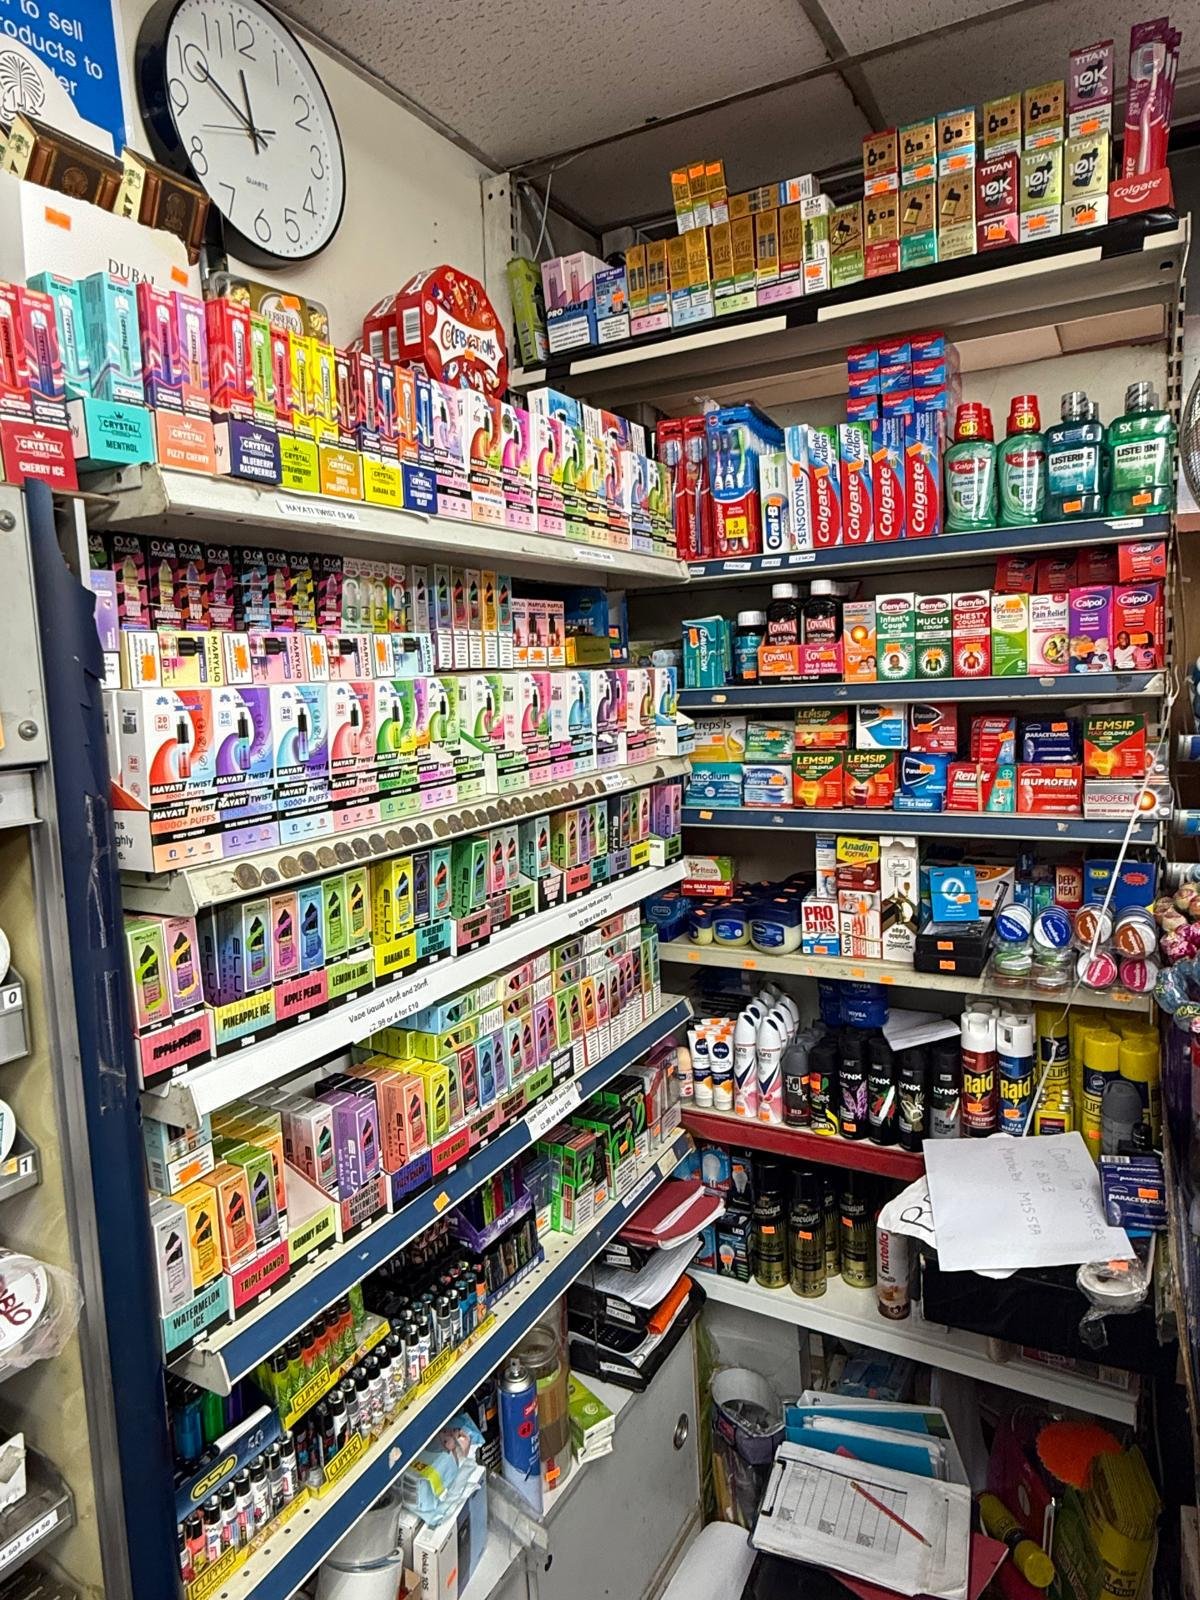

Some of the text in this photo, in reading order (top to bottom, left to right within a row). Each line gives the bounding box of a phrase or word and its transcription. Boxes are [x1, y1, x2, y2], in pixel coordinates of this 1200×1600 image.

[21, 0, 83, 42] to sell
[201, 12, 223, 58] 11
[229, 12, 256, 60] 12
[0, 16, 103, 79] oducts to
[175, 35, 209, 83] 10
[1075, 50, 1109, 64] TITAN
[273, 51, 279, 85] 1
[1074, 68, 1108, 87] 10K
[169, 78, 189, 116] 9
[293, 95, 311, 131] 2
[190, 136, 208, 175] 8
[310, 145, 324, 180] 3
[980, 161, 1013, 176] TITAN
[1069, 157, 1101, 177] 10K
[1025, 170, 1056, 188] 10K
[980, 181, 1011, 196] 10K
[1114, 179, 1162, 198] Colgate
[218, 182, 235, 218] 7
[303, 186, 317, 217] 4
[254, 209, 271, 242] 6
[285, 208, 300, 243] 5
[547, 308, 563, 319] PRO
[103, 419, 139, 433] CRYSTAL
[172, 429, 204, 442] CRYSTAL
[20, 438, 61, 454] CRYSTAL
[106, 439, 139, 453] MENTHOL
[243, 440, 273, 453] CRYSTAL
[820, 435, 828, 465] Action
[853, 429, 861, 460] Action
[19, 462, 65, 477] CHERRY ICE
[880, 466, 892, 536] Colgate
[912, 462, 925, 532] Colgate
[286, 504, 314, 514] HAYATI
[818, 475, 830, 542] Colgate
[847, 472, 861, 540] Colgate
[768, 505, 780, 546] Oral-B
[1131, 544, 1153, 553] Calpol
[881, 602, 909, 611] Benylin
[920, 602, 947, 611] Benylin
[957, 598, 985, 607] Benylin
[1075, 599, 1104, 608] Calpol
[1119, 595, 1149, 604] Calpol
[880, 615, 909, 624] Infant's
[917, 617, 950, 626] MUCUS
[954, 612, 988, 620] CHESTY
[1032, 609, 1066, 619] Pain Relief
[211, 636, 220, 682] MARYLIQ
[292, 636, 302, 679] MARYLIQ
[362, 637, 370, 677] MARYLIQ
[763, 652, 793, 663] COVONIA
[798, 710, 831, 719] LEMSIP
[1088, 720, 1135, 730] LEMSIP
[797, 756, 834, 765] LEMSIP
[847, 755, 886, 763] LEMSIP
[217, 772, 270, 785] HAYATI TWIST
[279, 767, 303, 776] HAYATI
[152, 781, 211, 794] HAYATI TWIST
[1020, 778, 1077, 786] IBUPROFEN
[279, 784, 327, 797] HAYATI TWIST
[218, 798, 246, 808] HAYATI
[251, 793, 272, 802] TWIST
[283, 799, 306, 808] 5000+
[308, 793, 329, 803] PUFFS
[1088, 794, 1130, 803] NUROFEN
[153, 803, 215, 820] HAYATI TWIST
[189, 814, 216, 823] PUFFS
[841, 842, 873, 853] Anadin
[1058, 875, 1076, 886] DEEP
[1058, 886, 1078, 896] HEAT
[804, 906, 834, 921] PRO
[384, 952, 403, 966] BANANA
[333, 970, 351, 986] LEMON
[357, 964, 369, 977] LIME
[348, 1011, 366, 1023] Vape
[402, 988, 414, 997] and
[399, 1007, 408, 1017] for
[223, 1003, 270, 1030] PINEAPPLE ICE
[839, 1071, 862, 1080] LYNX
[868, 1075, 890, 1085] LYNX
[964, 1072, 994, 1092] Raid
[899, 1082, 921, 1091] LYNX
[934, 1086, 959, 1095] LYNX
[1000, 1075, 1031, 1098] Raid
[21, 1159, 29, 1173] 1
[350, 1192, 380, 1216] WATERMELON
[1108, 1193, 1164, 1208] PARACETAMOL
[293, 1217, 329, 1251] GUMMY BEAR
[881, 1233, 890, 1273] nutella
[240, 1254, 285, 1292] TRIPLE MANGO
[172, 1287, 220, 1329] WATERMELON
[193, 1315, 204, 1329] ICE
[423, 1352, 451, 1383] CLIPPER
[293, 1369, 330, 1408] CLIPPER
[325, 1442, 362, 1476] CLIPPER
[191, 1553, 236, 1596] CLIPPER
